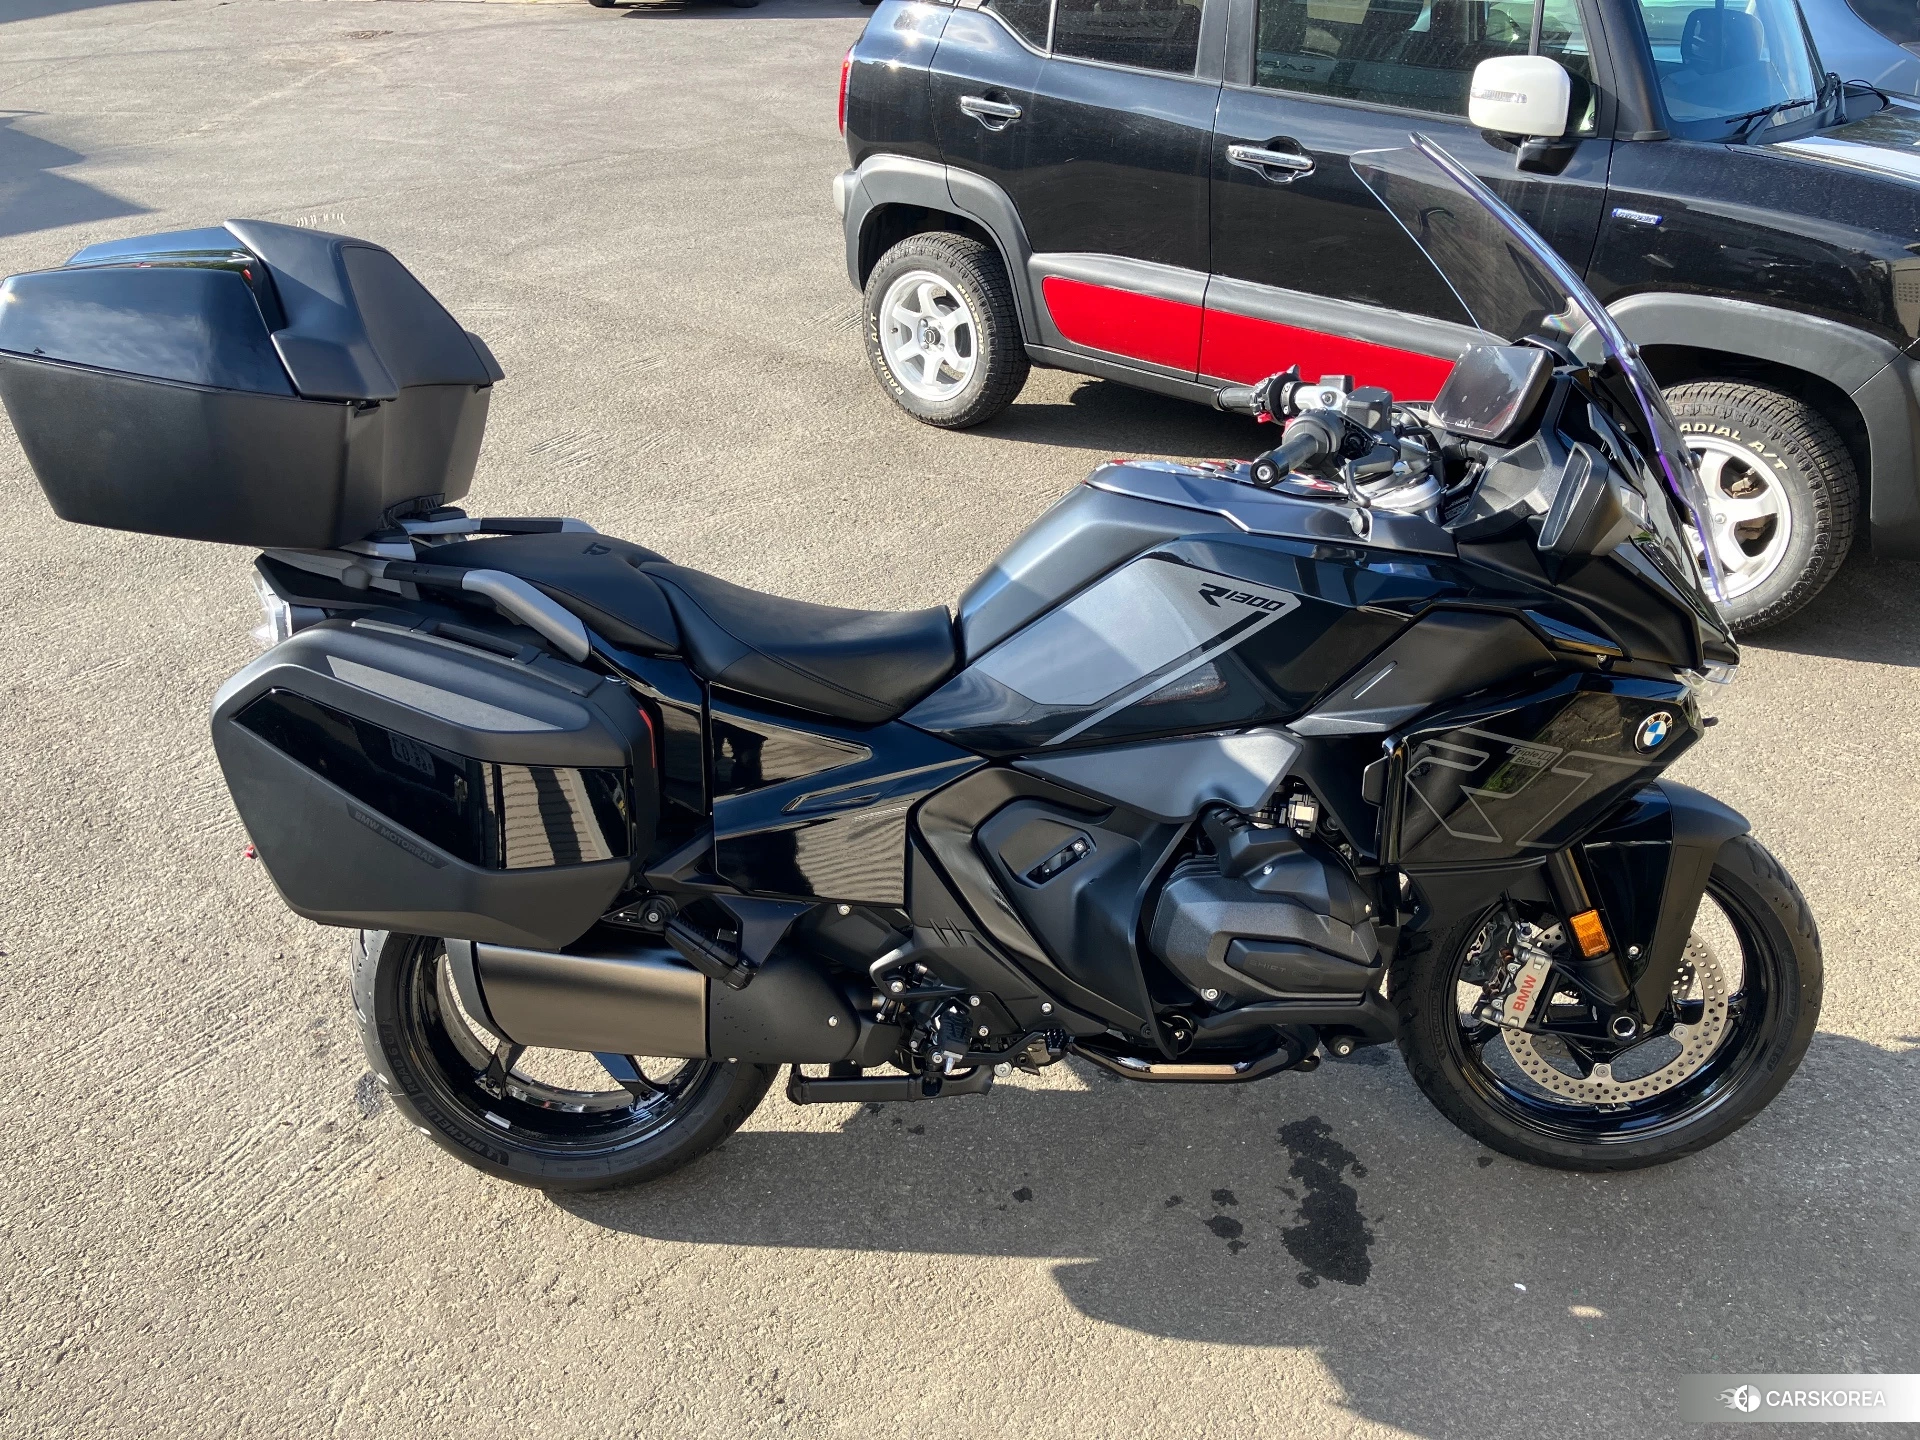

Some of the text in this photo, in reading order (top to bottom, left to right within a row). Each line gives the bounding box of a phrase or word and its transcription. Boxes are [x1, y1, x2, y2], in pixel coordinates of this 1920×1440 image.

[956, 282, 985, 355] MUDSTAR
[870, 312, 904, 396] RADIAL A/T
[1679, 422, 1790, 470] ADIAL A/T
[1511, 746, 1539, 757] Triple
[1515, 756, 1541, 767] Black
[354, 810, 436, 864] BMW MOTORRAD
[1513, 974, 1537, 1011] BMW
[393, 1058, 418, 1095] ROAD
[420, 1102, 486, 1152] MICHELIN
